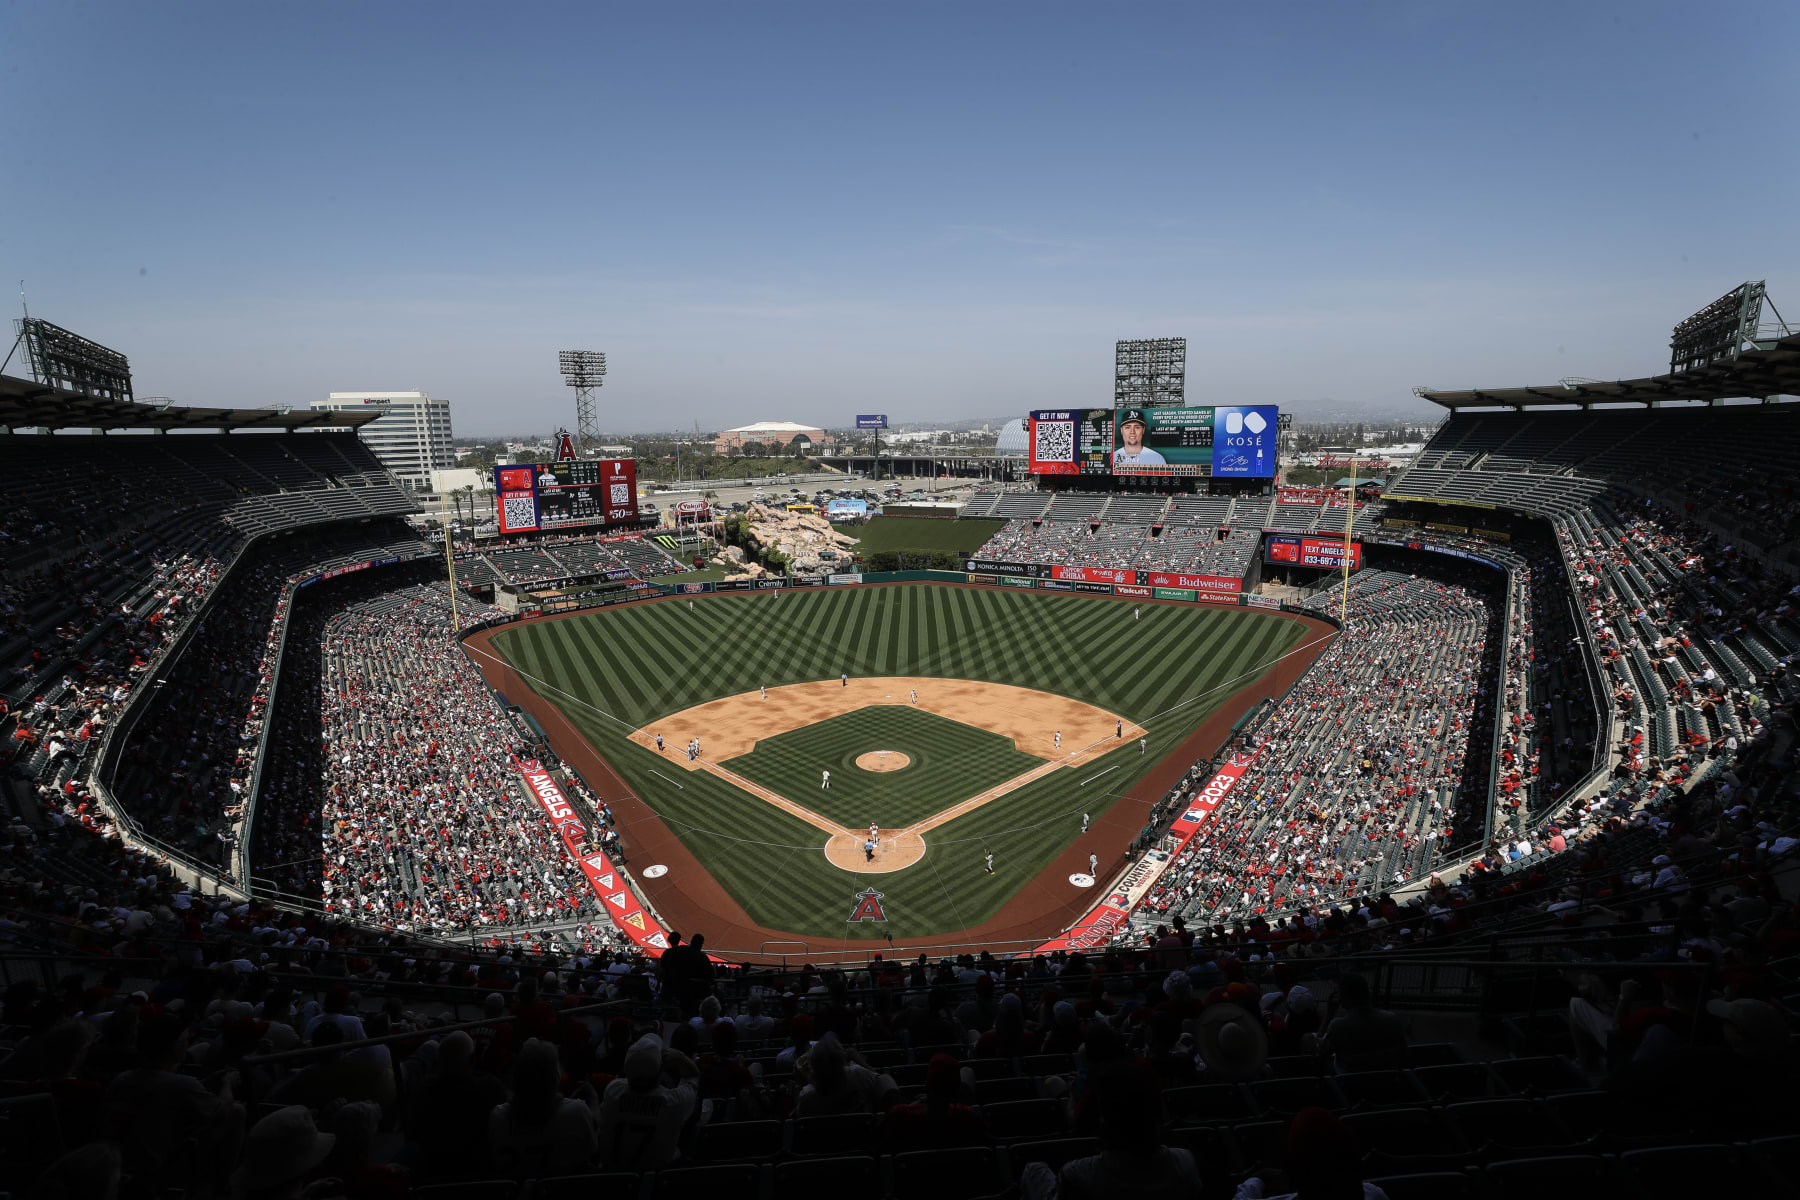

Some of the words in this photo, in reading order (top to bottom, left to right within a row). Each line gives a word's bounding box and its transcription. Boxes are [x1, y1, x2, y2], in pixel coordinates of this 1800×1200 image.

[1040, 412, 1049, 420] GET
[1050, 412, 1056, 420] IT
[1056, 412, 1070, 420] NOW
[1227, 435, 1263, 446] KOSÉ
[1304, 546, 1320, 554] TEXT
[1320, 547, 1344, 556] ANGELS
[1304, 556, 1354, 568] 833-697-107
[1060, 572, 1086, 580] ICHIBAN
[1179, 576, 1235, 589] Budweiser
[1118, 587, 1149, 595] Yakult
[1248, 596, 1280, 604] NEXGEN
[1198, 774, 1234, 805] 2023
[529, 774, 572, 818] ANGELS
[1118, 859, 1153, 892] COUNTRY
[618, 1096, 662, 1117] OHTANI
[614, 1121, 658, 1166] 17
